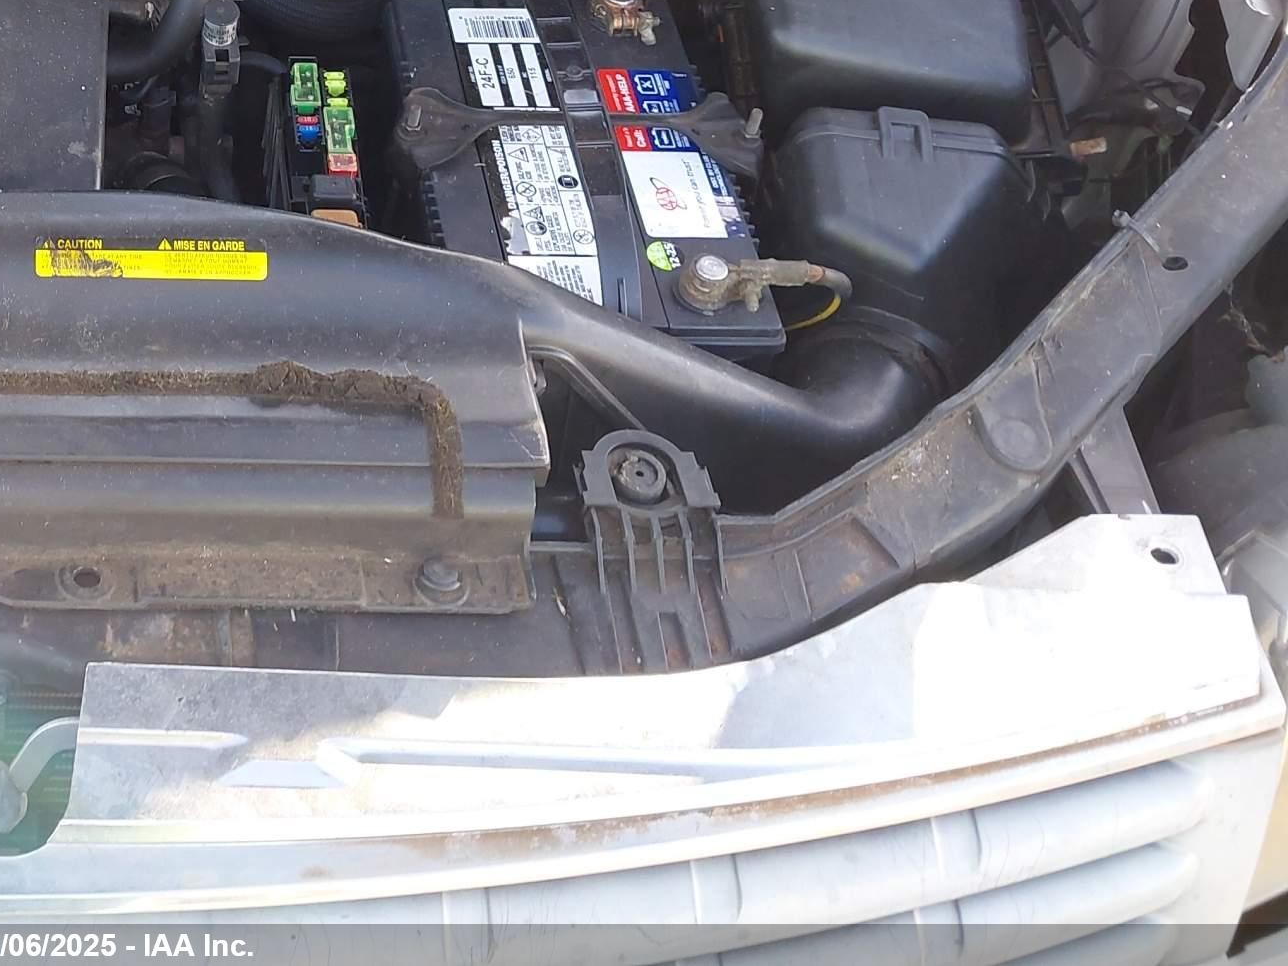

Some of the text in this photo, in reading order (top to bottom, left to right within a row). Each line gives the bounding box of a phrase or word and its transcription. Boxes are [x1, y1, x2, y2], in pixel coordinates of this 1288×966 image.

[475, 57, 496, 90] 24F-C
[57, 238, 103, 249] CAUTION
[173, 240, 245, 251] MISE EN GARDE
